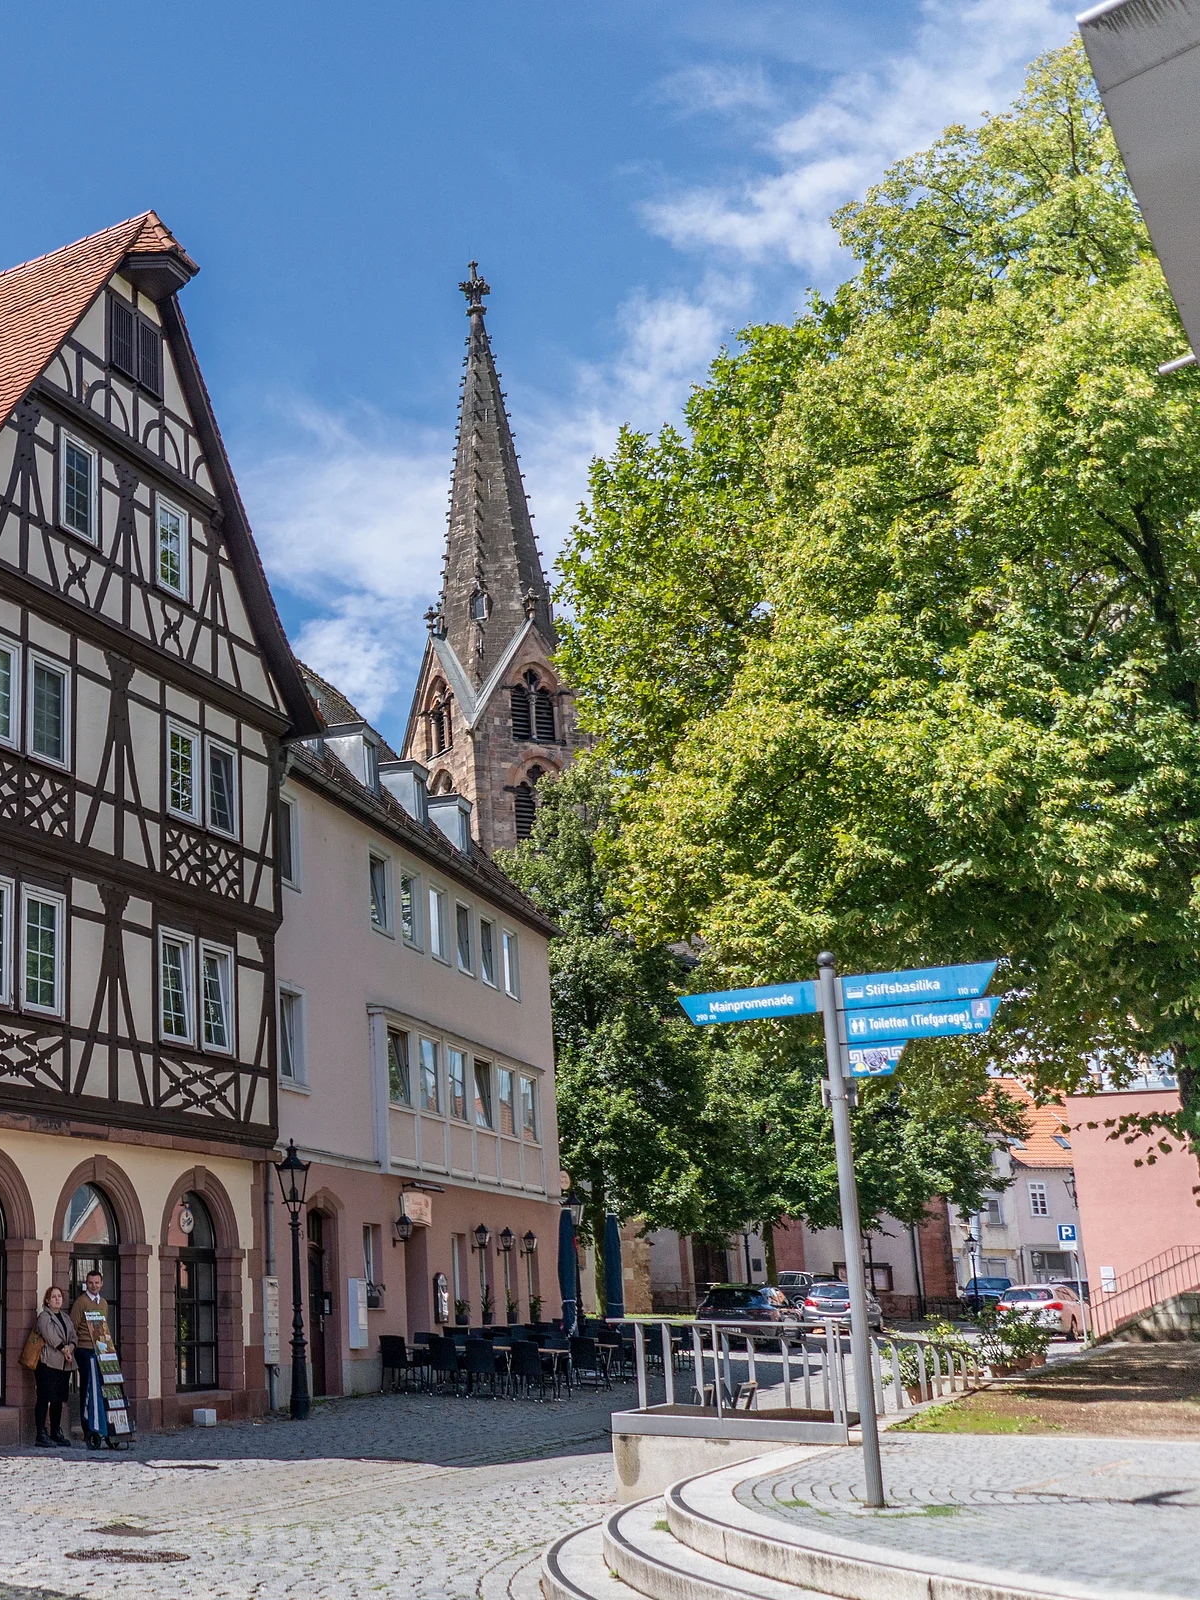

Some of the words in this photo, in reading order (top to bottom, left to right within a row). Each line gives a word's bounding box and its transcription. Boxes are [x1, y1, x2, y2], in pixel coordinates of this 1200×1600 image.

[865, 979, 940, 996] Stiftsbasilika
[957, 987, 969, 995] 110
[709, 994, 794, 1013] Mainpromenade
[695, 1014, 708, 1022] 290
[868, 1016, 908, 1030] Toiletten
[911, 1010, 970, 1027] (Tiefgarage)
[962, 1021, 973, 1030] 50
[1060, 1226, 1072, 1240] P
